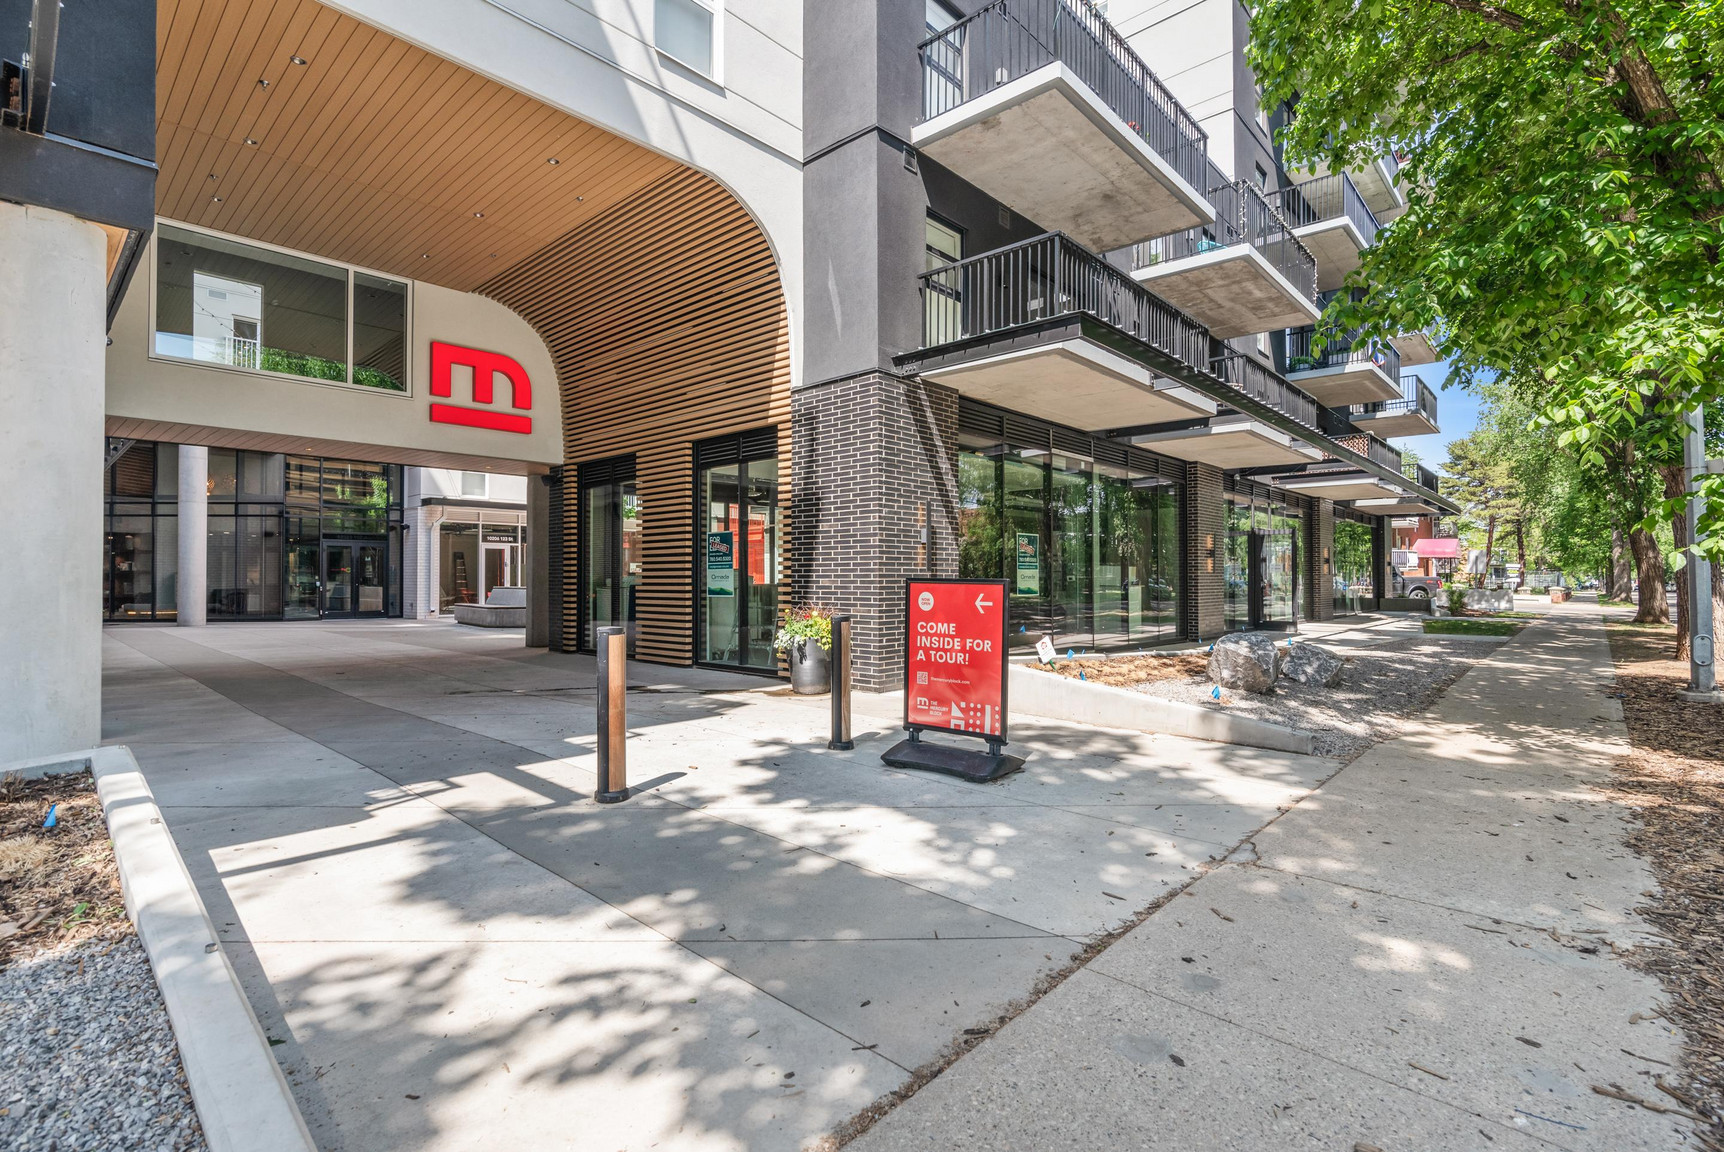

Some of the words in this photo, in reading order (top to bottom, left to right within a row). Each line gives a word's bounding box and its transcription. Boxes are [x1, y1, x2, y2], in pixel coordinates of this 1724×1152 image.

[917, 622, 956, 635] COME
[917, 635, 961, 650] INSIDE
[966, 639, 992, 652] FOR
[916, 649, 926, 661] A
[929, 650, 969, 665] TOUR!
